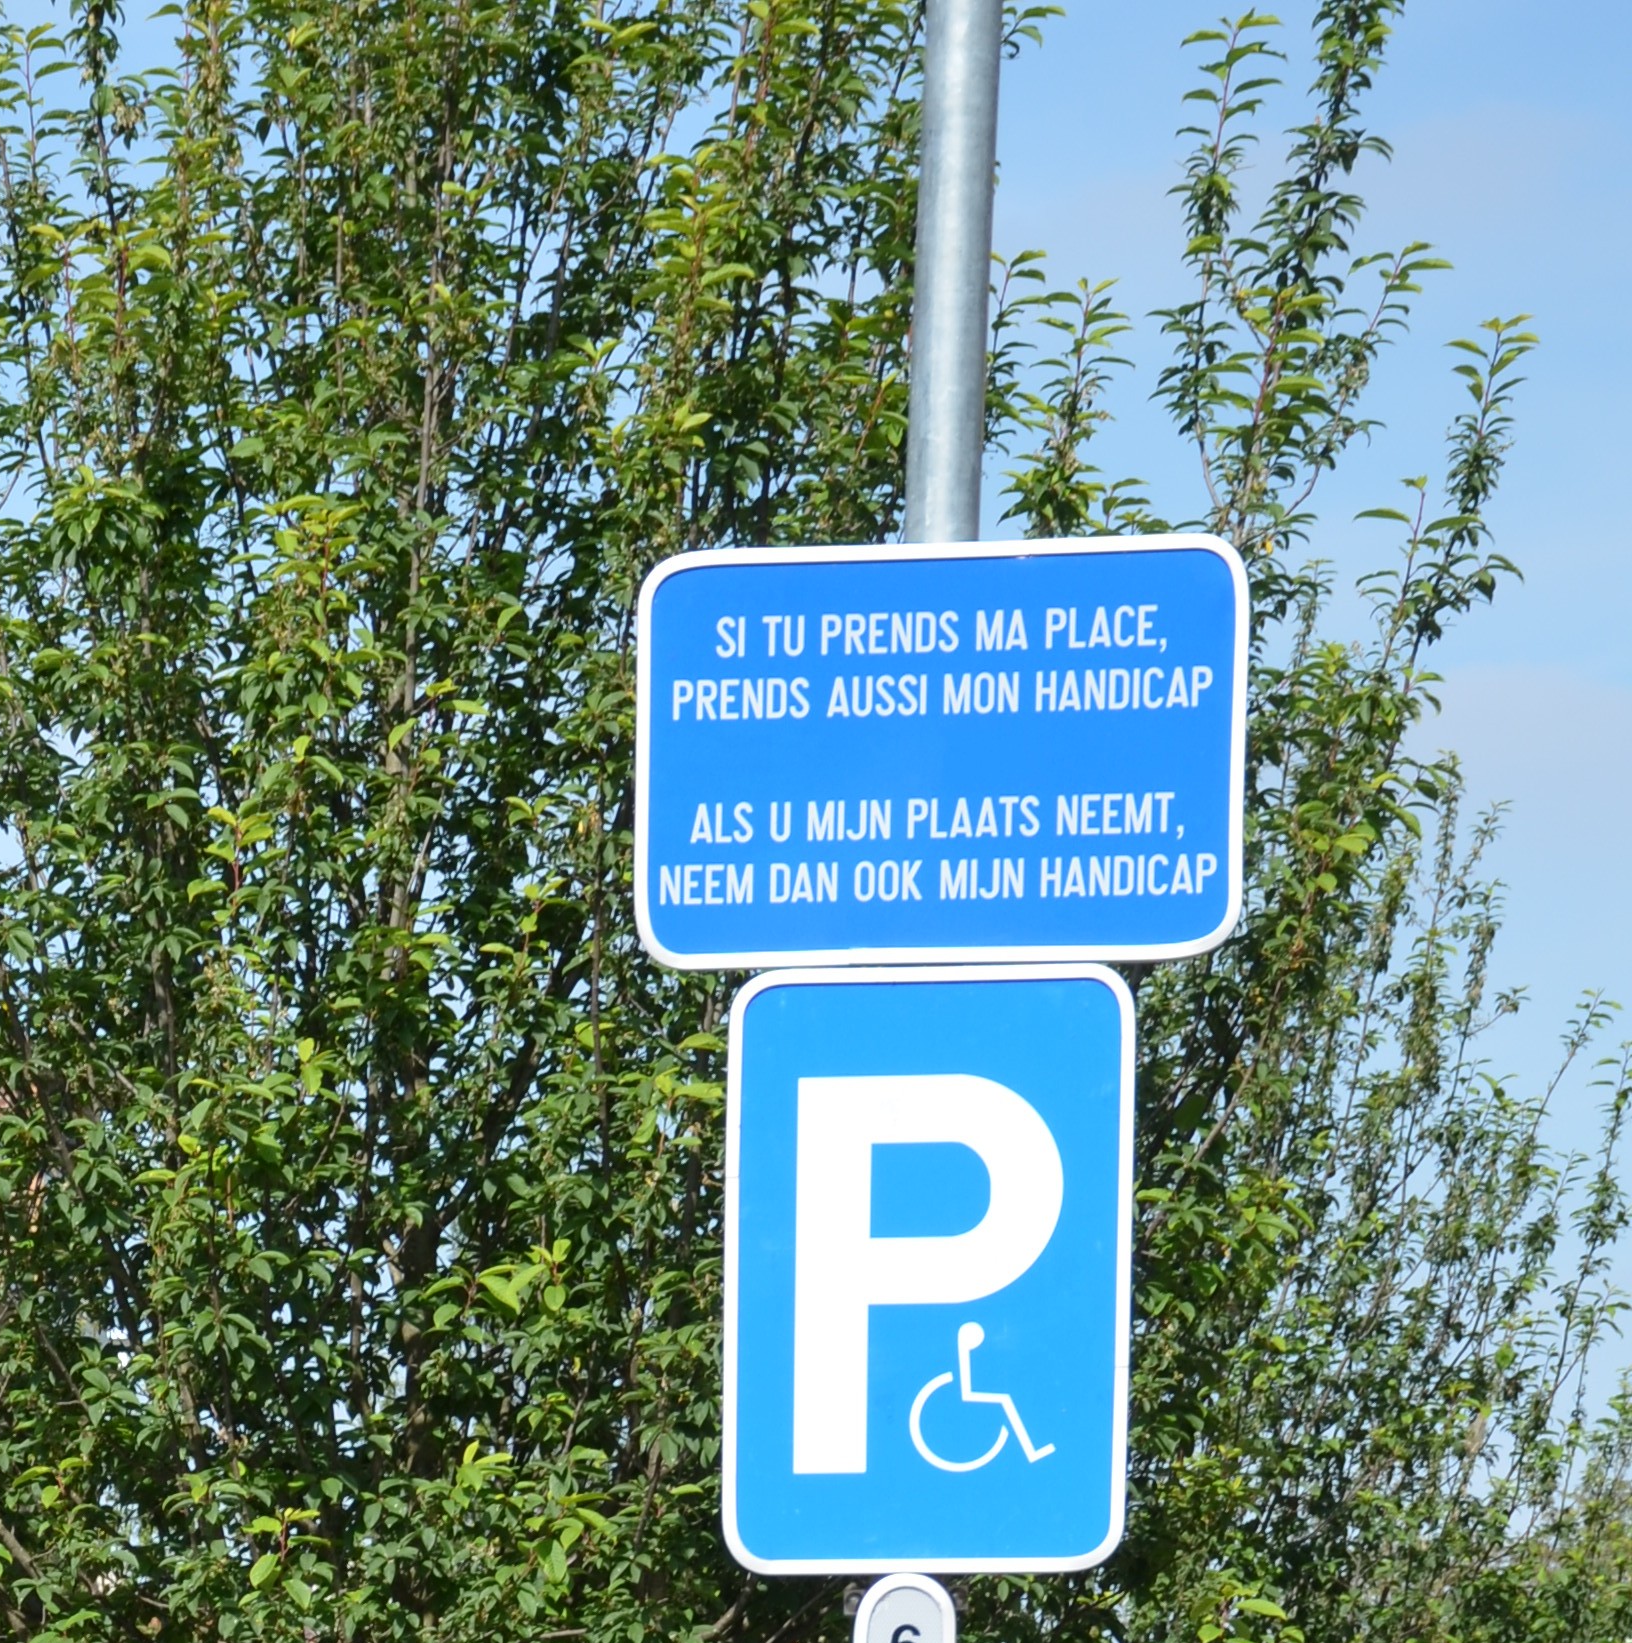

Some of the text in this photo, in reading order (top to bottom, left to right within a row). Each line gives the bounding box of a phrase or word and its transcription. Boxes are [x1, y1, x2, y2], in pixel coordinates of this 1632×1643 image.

[715, 604, 1167, 659] SI TU PRENDS MA PLACE,
[672, 665, 1213, 721] PRENDS AUSSI MON HANDICAP
[689, 791, 1184, 844] ALS U MIJN PLAATS NEEMT,
[659, 852, 1218, 906] NEEM DAN OOK MIJN HANDICAP
[792, 1073, 1065, 1475] P
